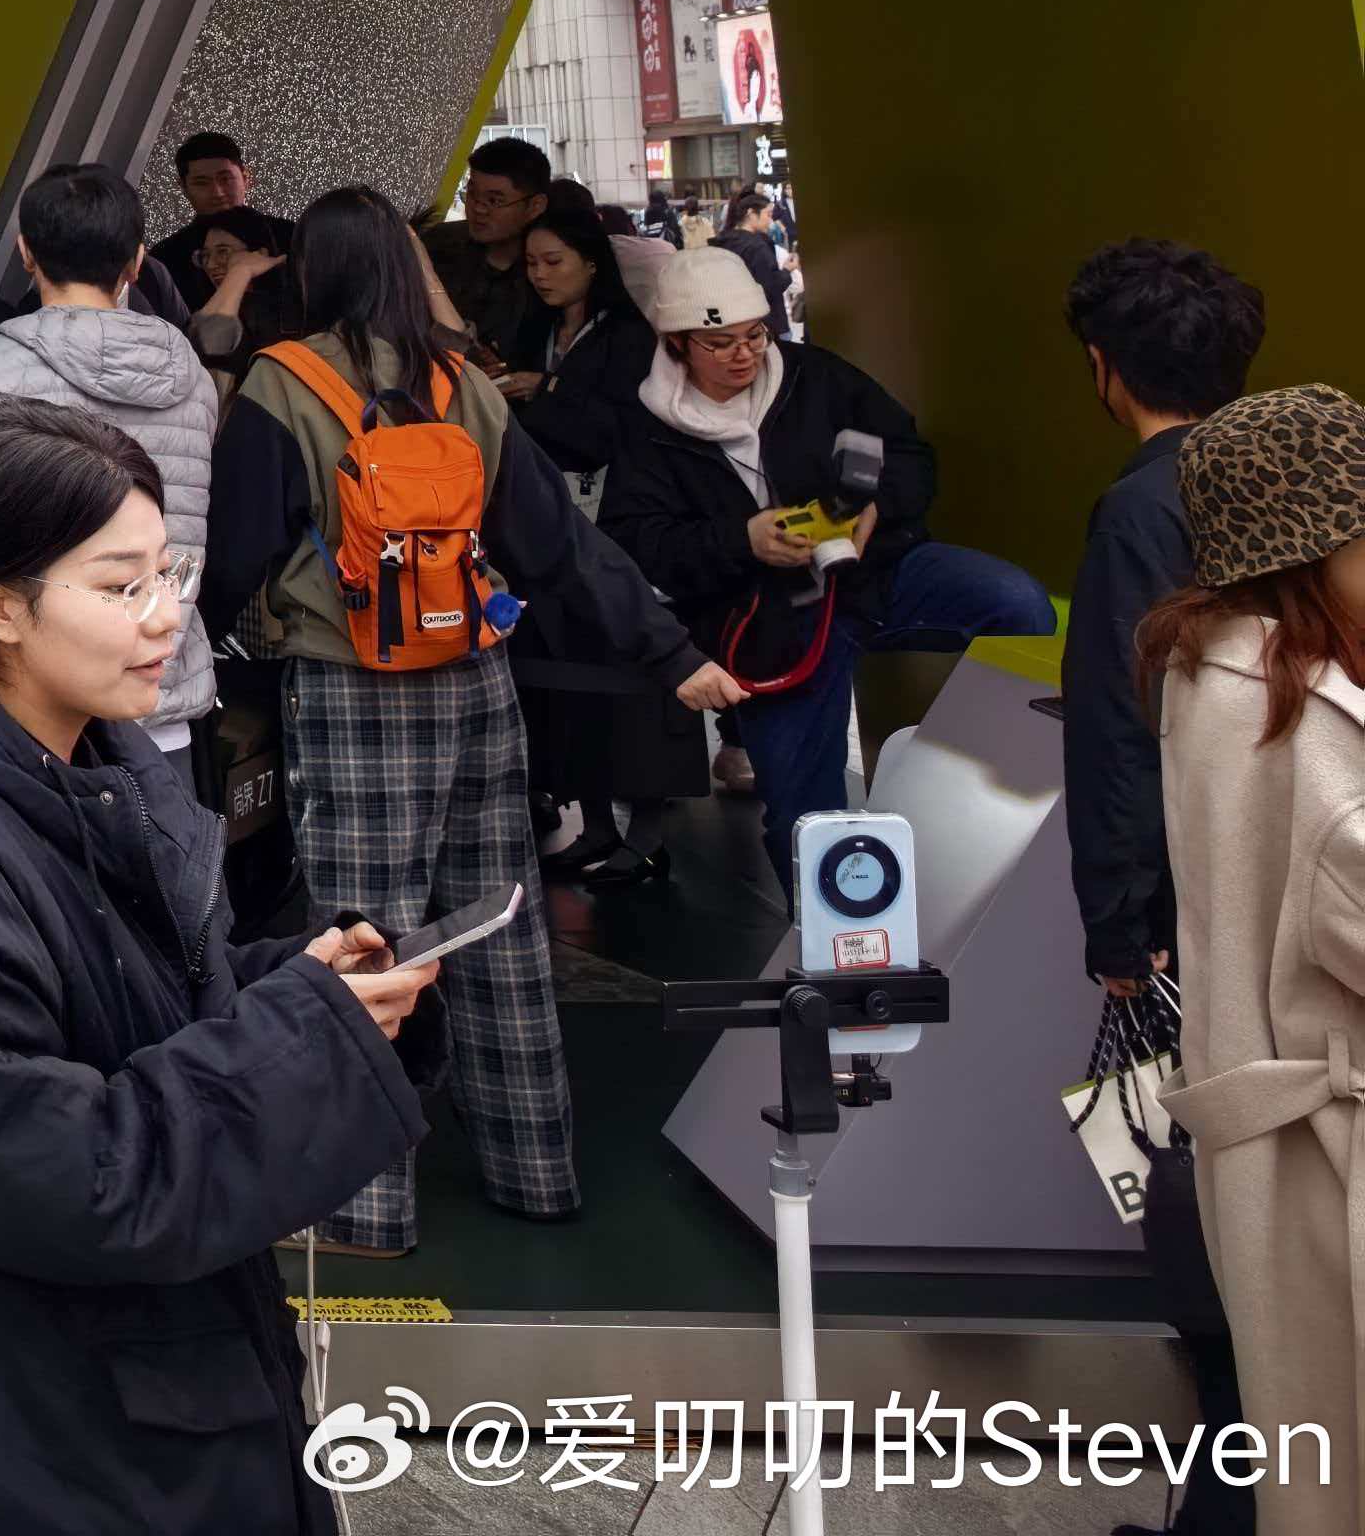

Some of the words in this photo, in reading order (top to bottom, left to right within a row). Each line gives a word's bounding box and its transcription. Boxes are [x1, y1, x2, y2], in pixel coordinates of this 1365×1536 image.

[422, 613, 463, 625] OUTDOOR
[233, 780, 255, 822] 尚界
[256, 770, 274, 807] Z7
